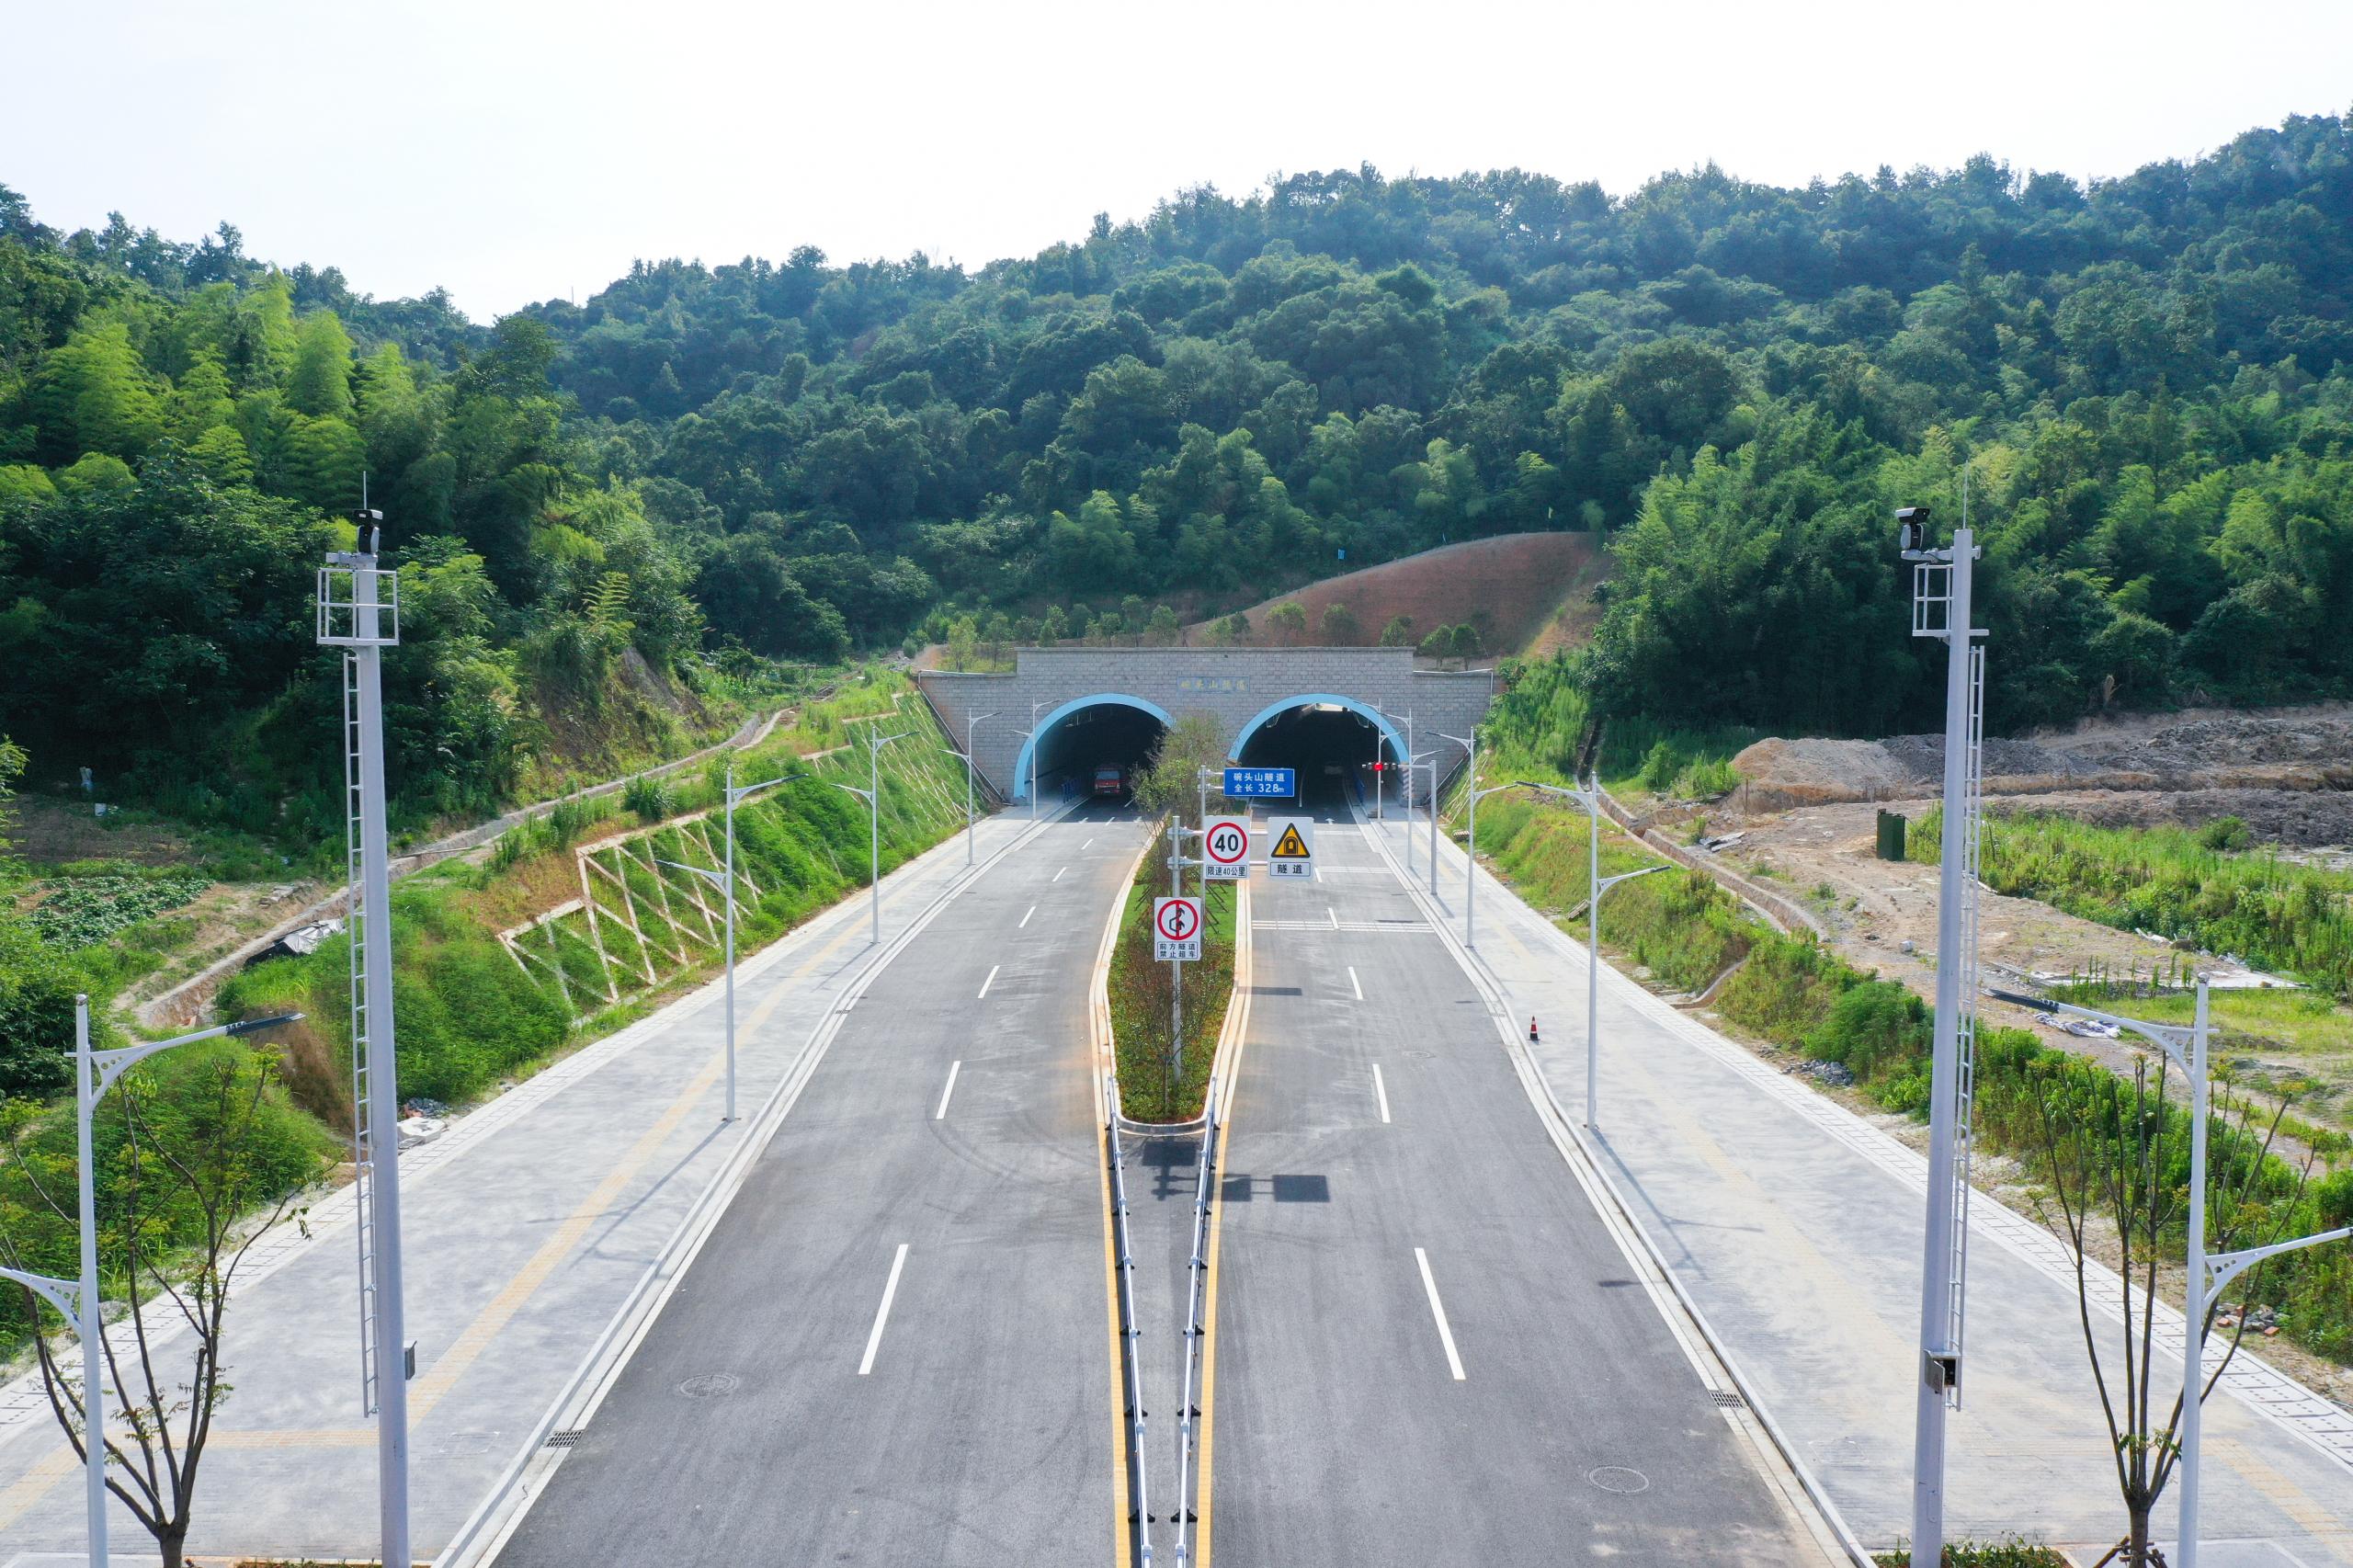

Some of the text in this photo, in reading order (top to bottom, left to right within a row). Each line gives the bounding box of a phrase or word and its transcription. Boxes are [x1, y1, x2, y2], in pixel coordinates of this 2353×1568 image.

[1234, 783, 1285, 793] 全长 328m
[1214, 834, 1239, 852] 40
[1207, 866, 1245, 876] 限速40公里
[1277, 864, 1302, 874] 隧道
[1159, 950, 1196, 959] 禁止超车
